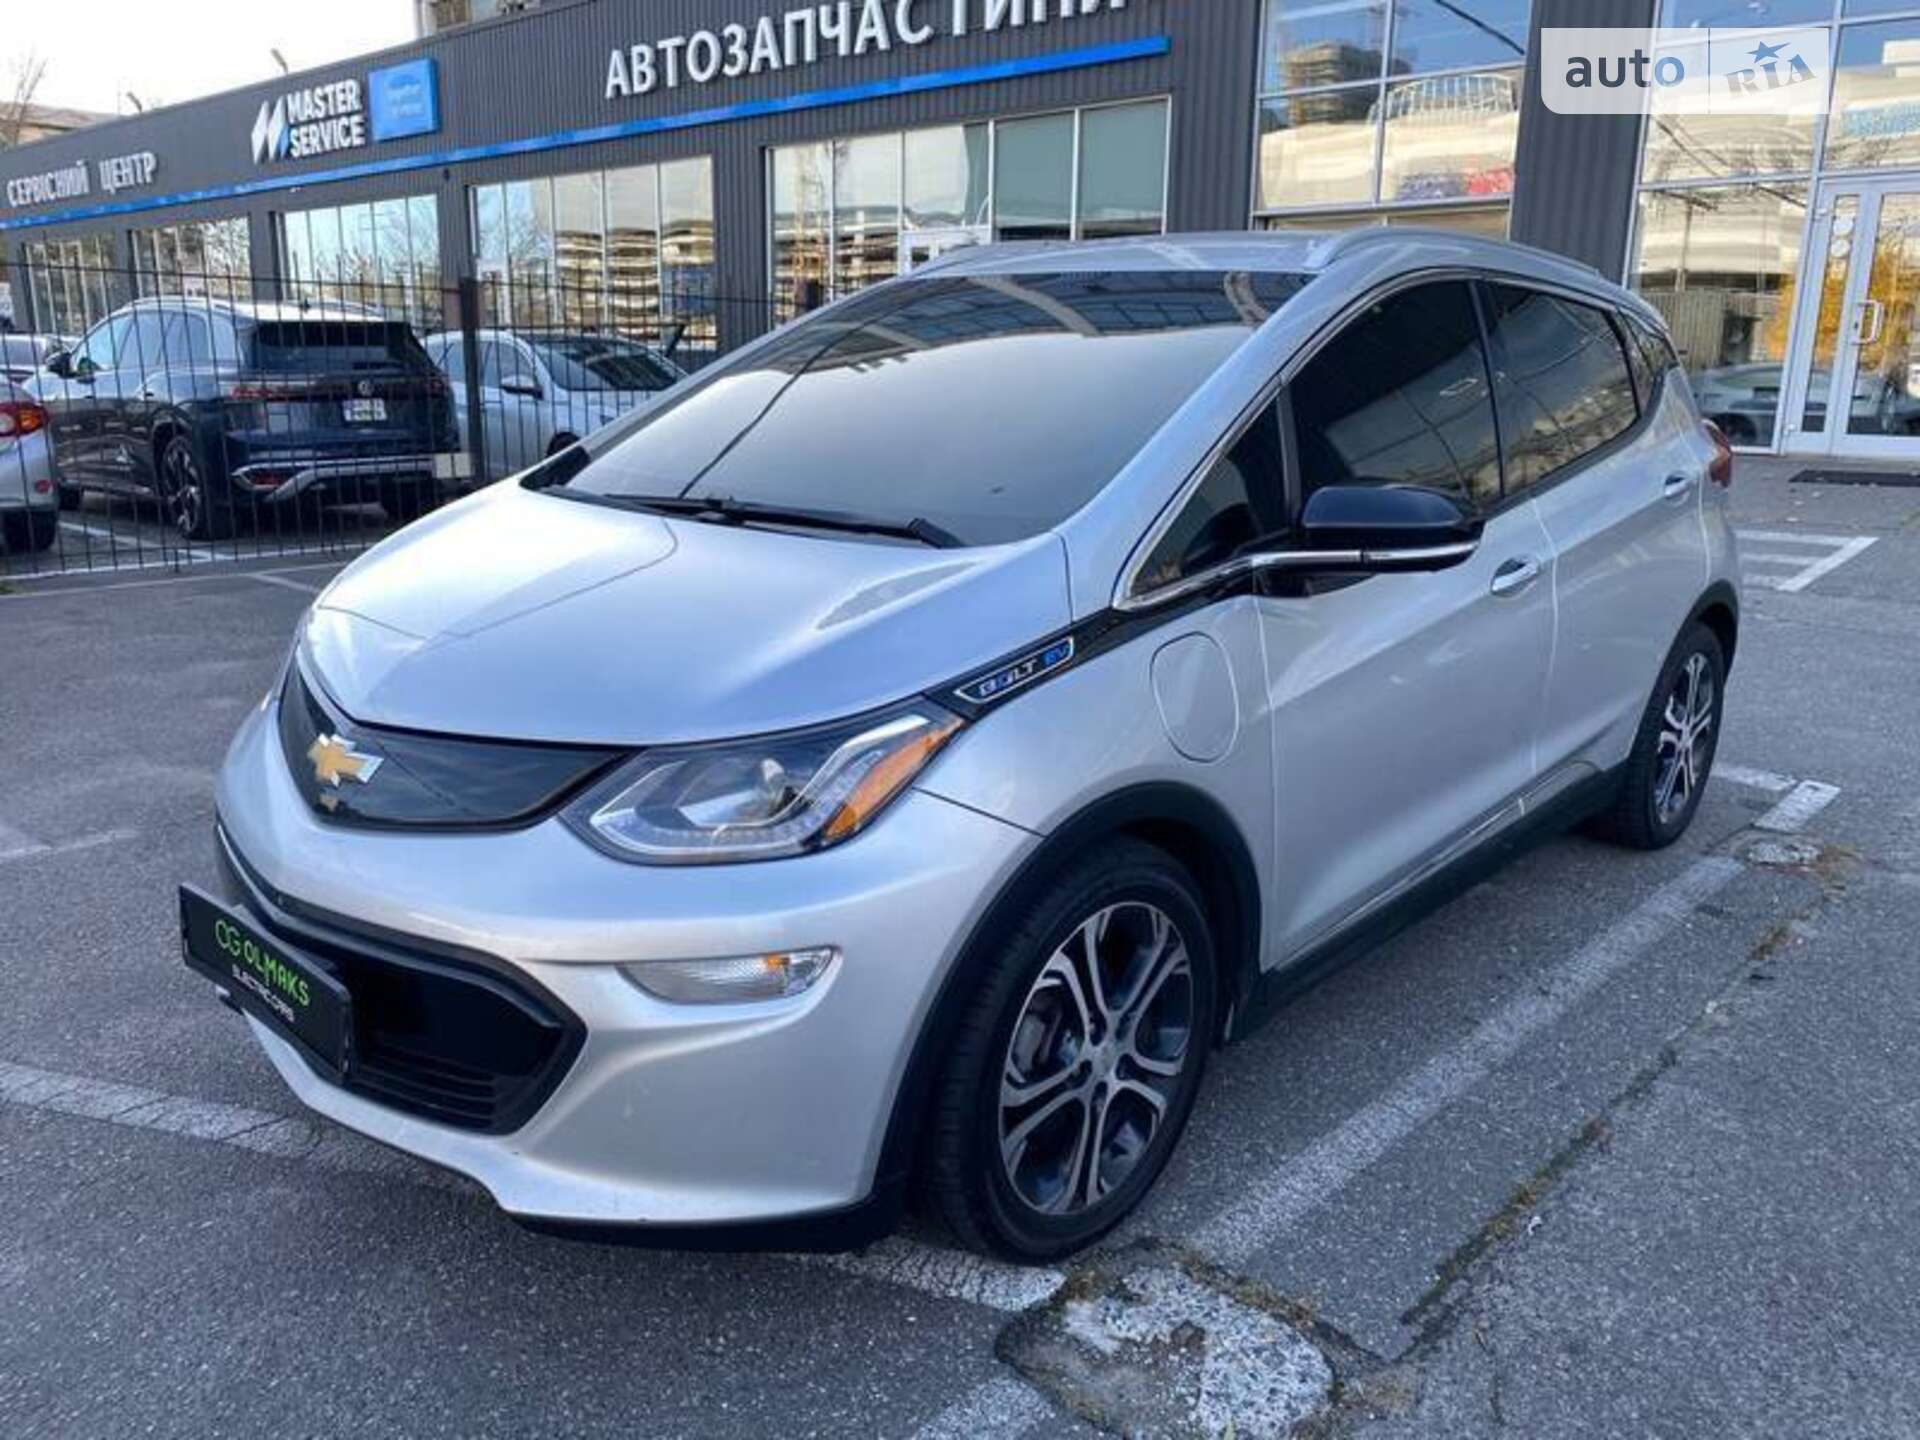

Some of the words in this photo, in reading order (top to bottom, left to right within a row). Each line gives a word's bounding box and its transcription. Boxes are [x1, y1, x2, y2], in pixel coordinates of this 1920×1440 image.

[605, 0, 1127, 99] АВТОЗАПЧАСТИ
[287, 79, 362, 123] MASTER
[290, 114, 366, 158] SERVICE
[99, 152, 157, 195] ЦЕНТР
